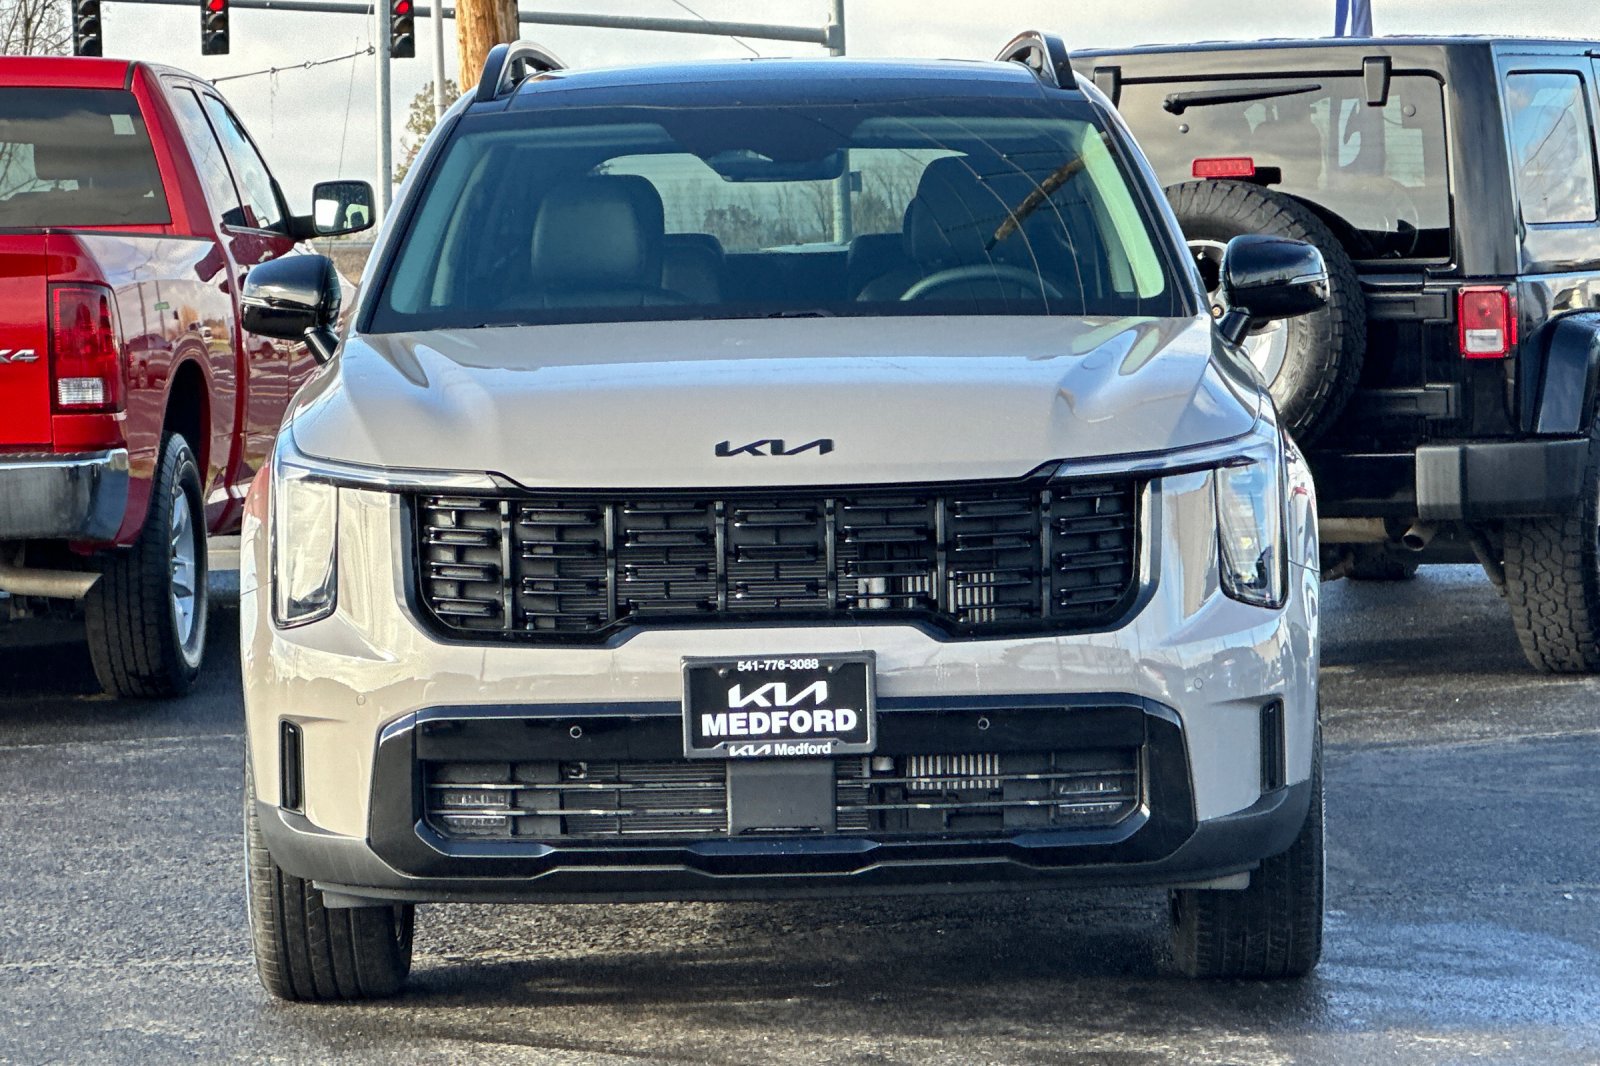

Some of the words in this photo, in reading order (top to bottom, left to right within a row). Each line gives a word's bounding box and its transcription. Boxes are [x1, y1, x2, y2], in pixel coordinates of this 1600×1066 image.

[715, 439, 834, 457] KIA
[737, 658, 819, 672] 541-776-3088
[728, 680, 828, 708] KIA
[701, 708, 857, 737] MEDFORD
[729, 744, 770, 757] KIA
[774, 742, 832, 756] Medford
